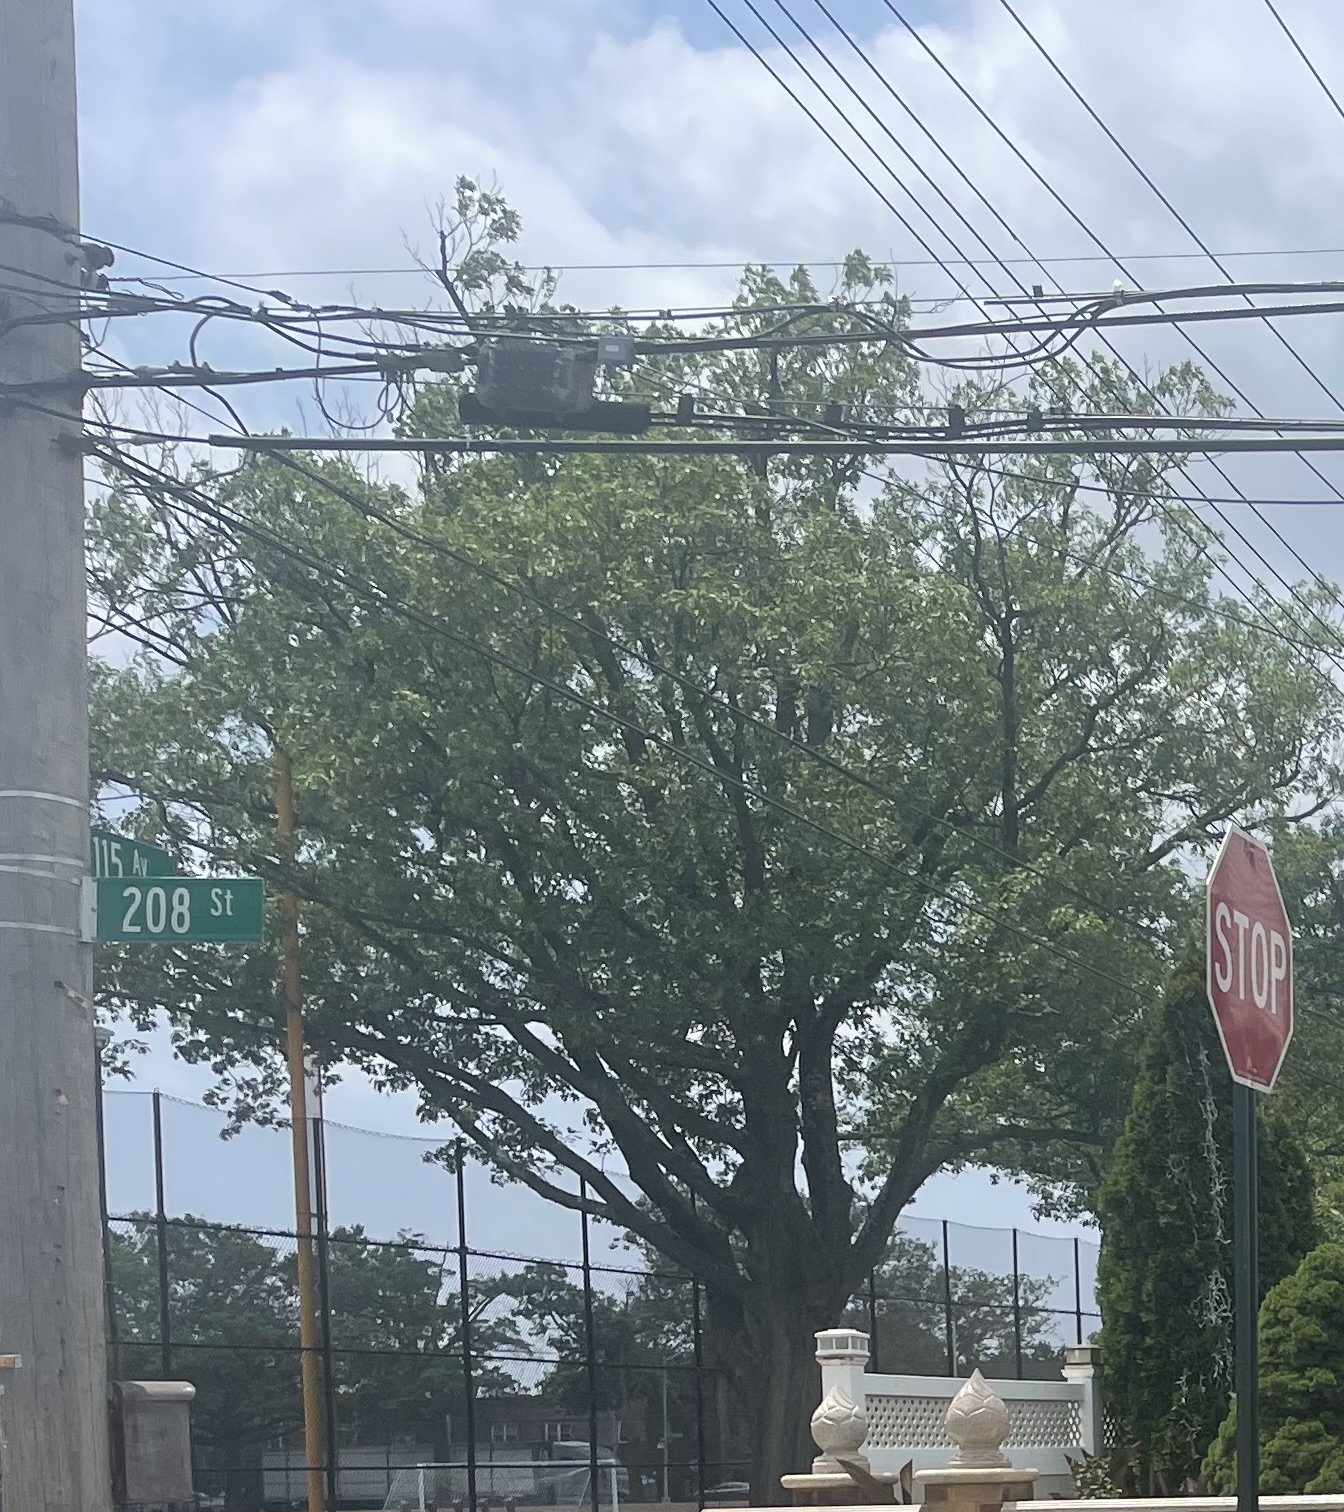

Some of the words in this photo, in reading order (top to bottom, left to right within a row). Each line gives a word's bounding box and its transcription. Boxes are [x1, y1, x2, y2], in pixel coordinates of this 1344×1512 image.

[92, 836, 123, 878] 115
[132, 849, 148, 878] Av
[122, 886, 191, 934] 208
[210, 888, 234, 916] St
[1215, 902, 1287, 1014] STOP
